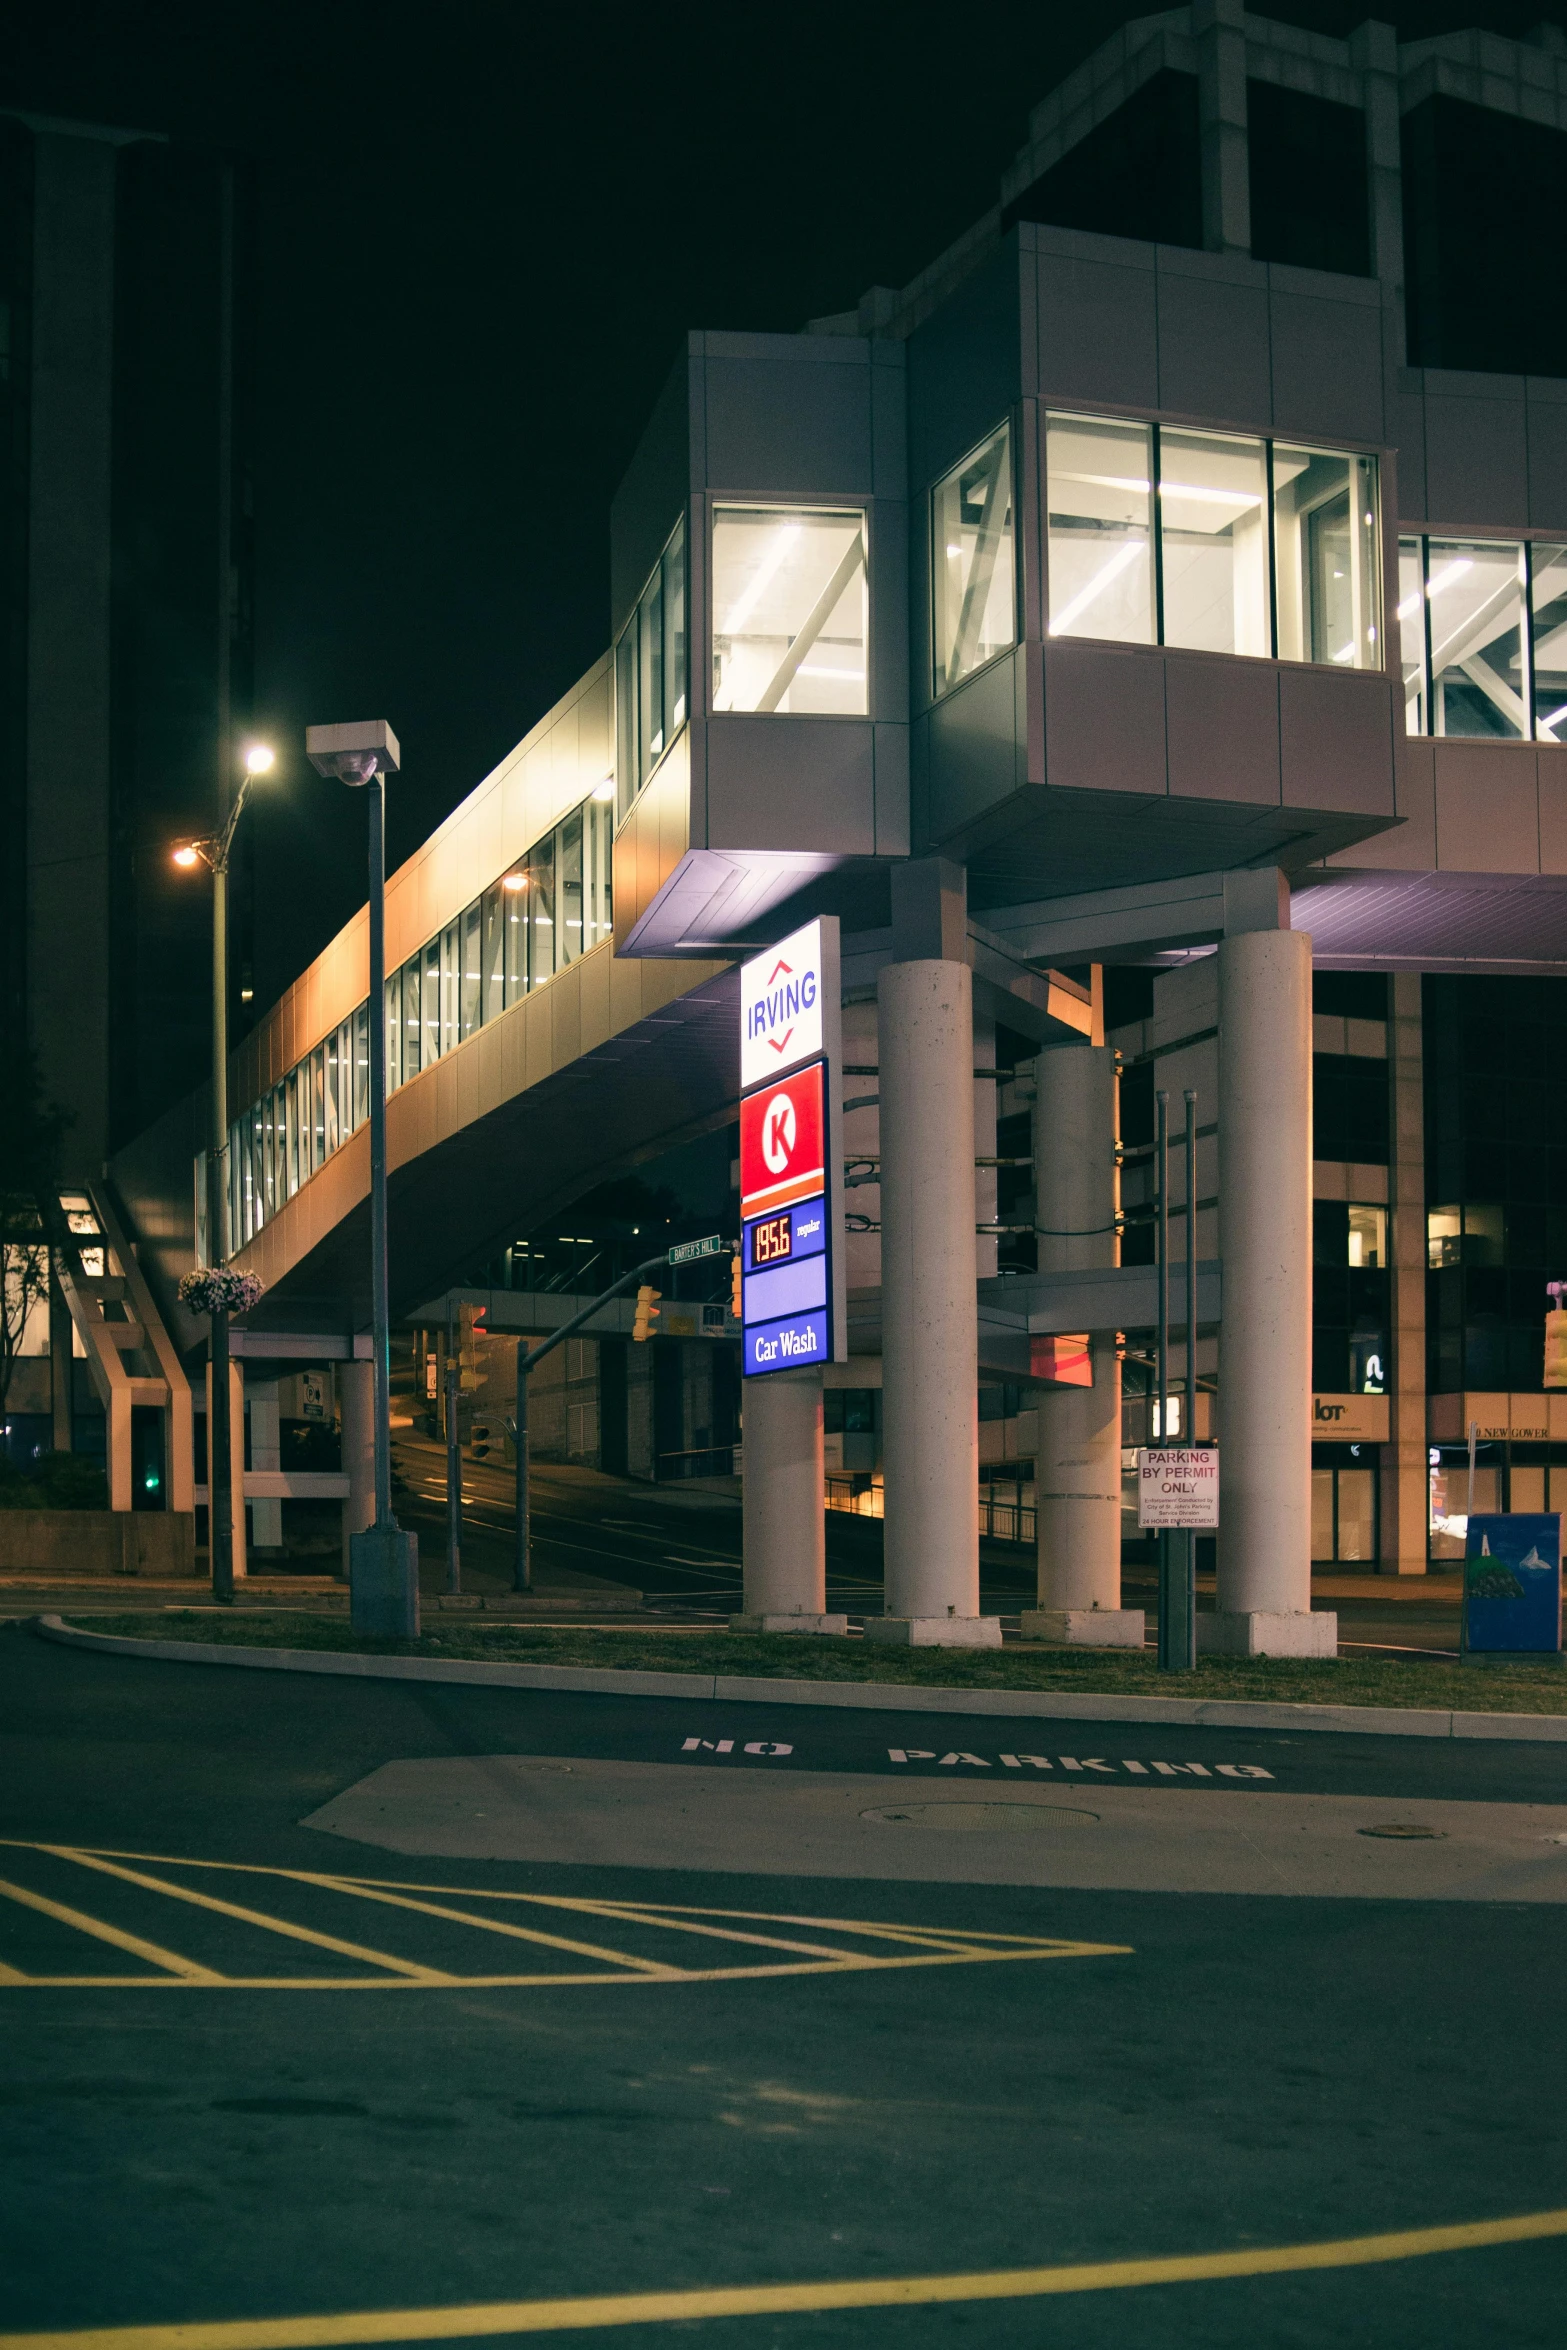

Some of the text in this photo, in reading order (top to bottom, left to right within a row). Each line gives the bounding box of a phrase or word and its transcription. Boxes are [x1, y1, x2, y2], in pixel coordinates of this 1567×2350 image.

[748, 970, 817, 1040] IRVING
[797, 1219, 821, 1238] regular
[674, 1240, 714, 1261] BARTER'S HILL
[755, 1325, 817, 1363] Car Wash
[1485, 1428, 1507, 1438] NEW
[1511, 1428, 1548, 1438] GOWER
[1148, 1452, 1209, 1463] PARKING
[1142, 1467, 1215, 1478] BY PERMIT
[1161, 1482, 1197, 1493] ONLY
[681, 1737, 795, 1757] NO
[887, 1748, 1276, 1780] PARKING
